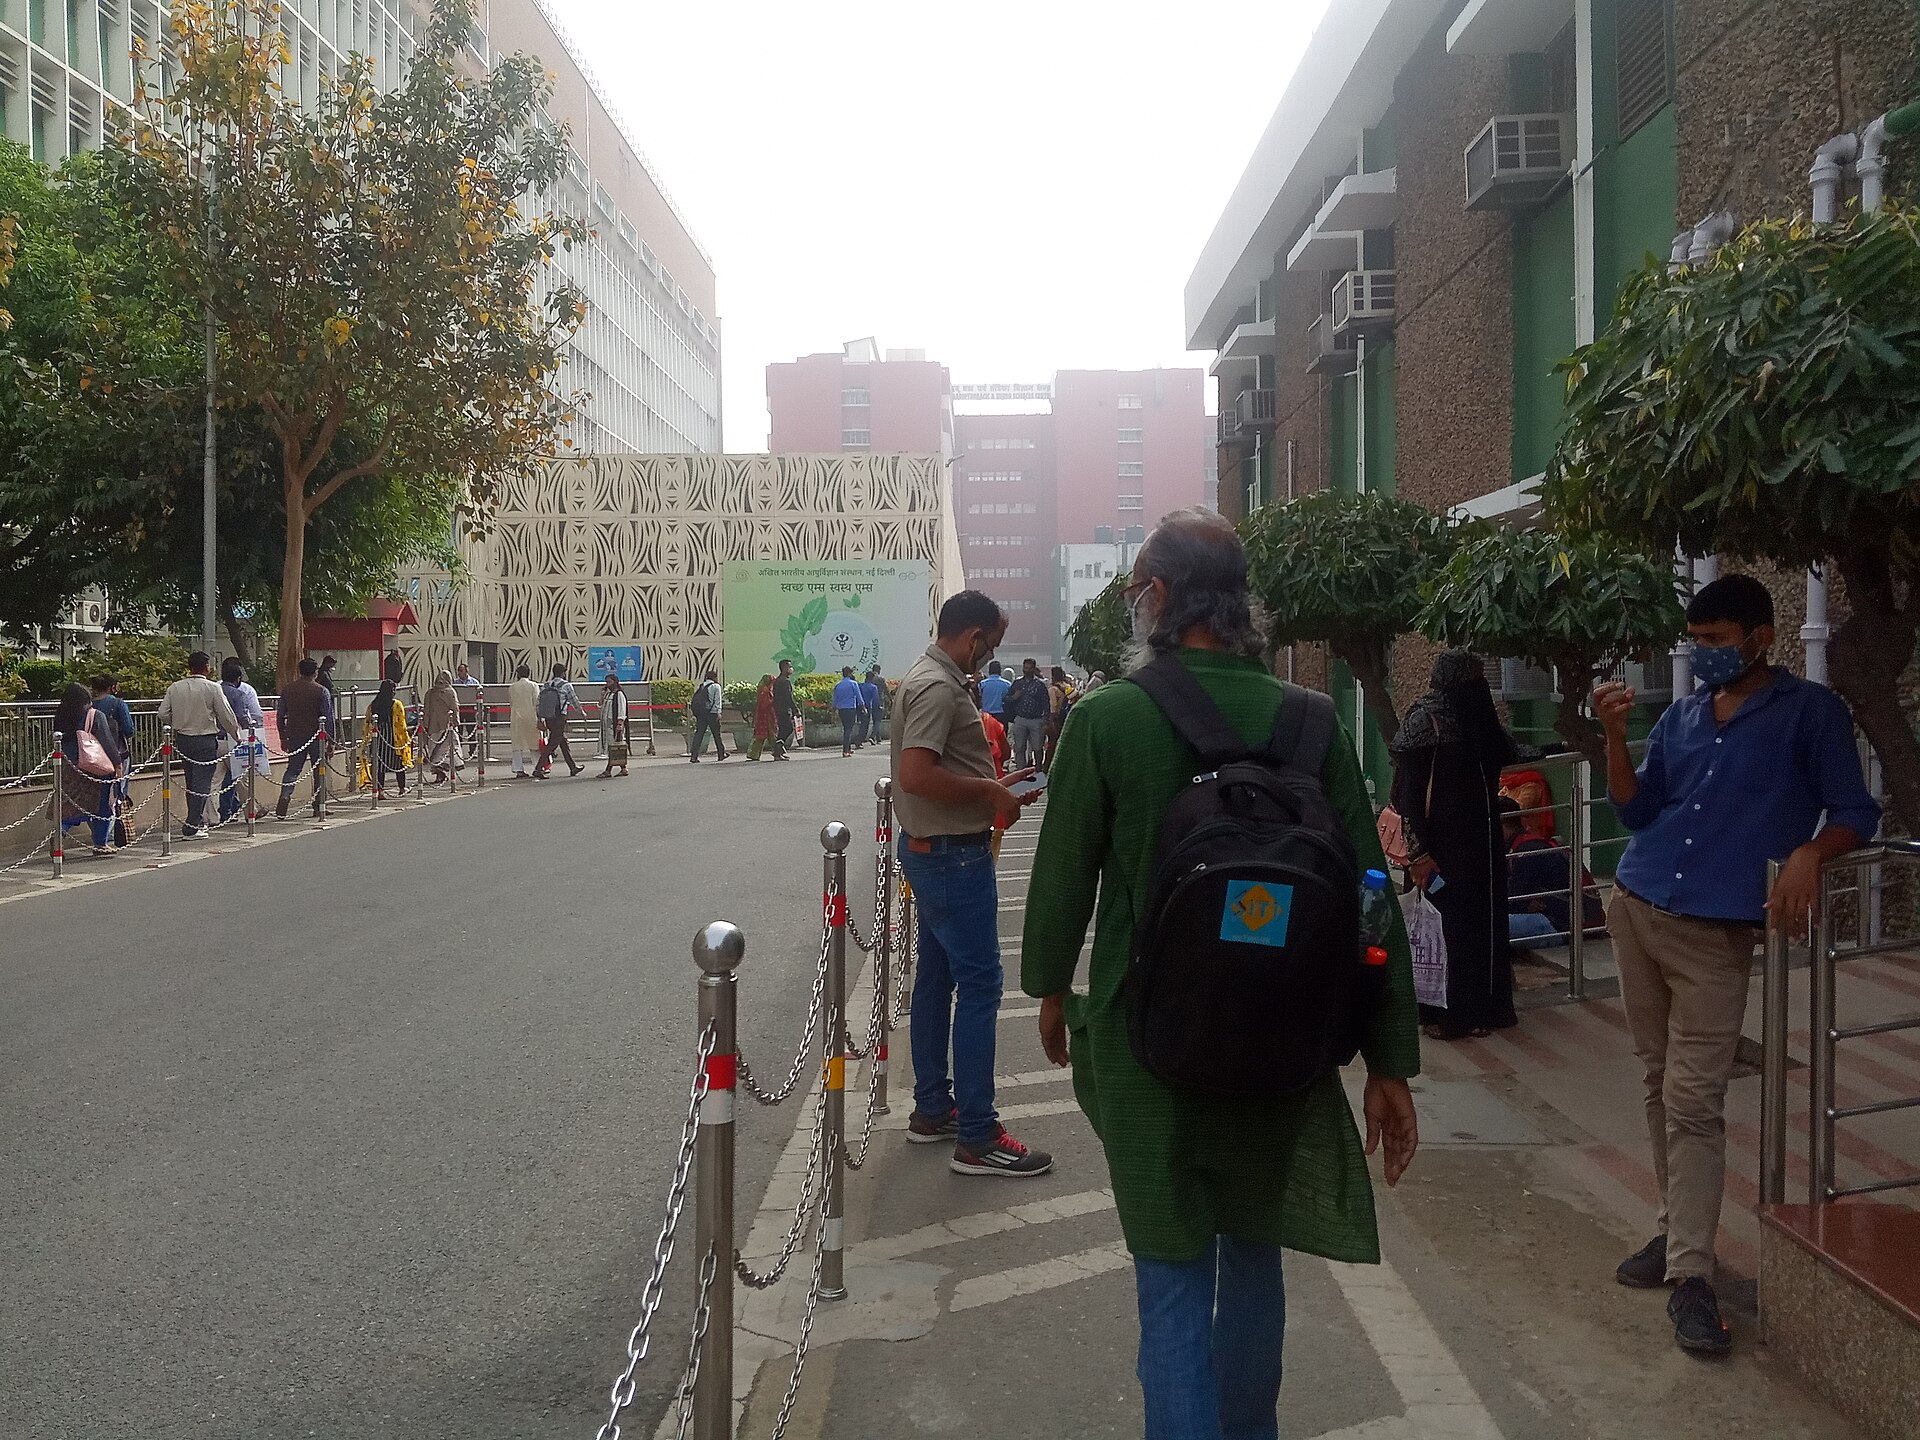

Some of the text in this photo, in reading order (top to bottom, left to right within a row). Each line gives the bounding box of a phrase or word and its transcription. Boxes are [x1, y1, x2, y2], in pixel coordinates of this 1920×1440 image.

[780, 583, 873, 594] स्वच्छ एम्स स्वस्थ एम्स
